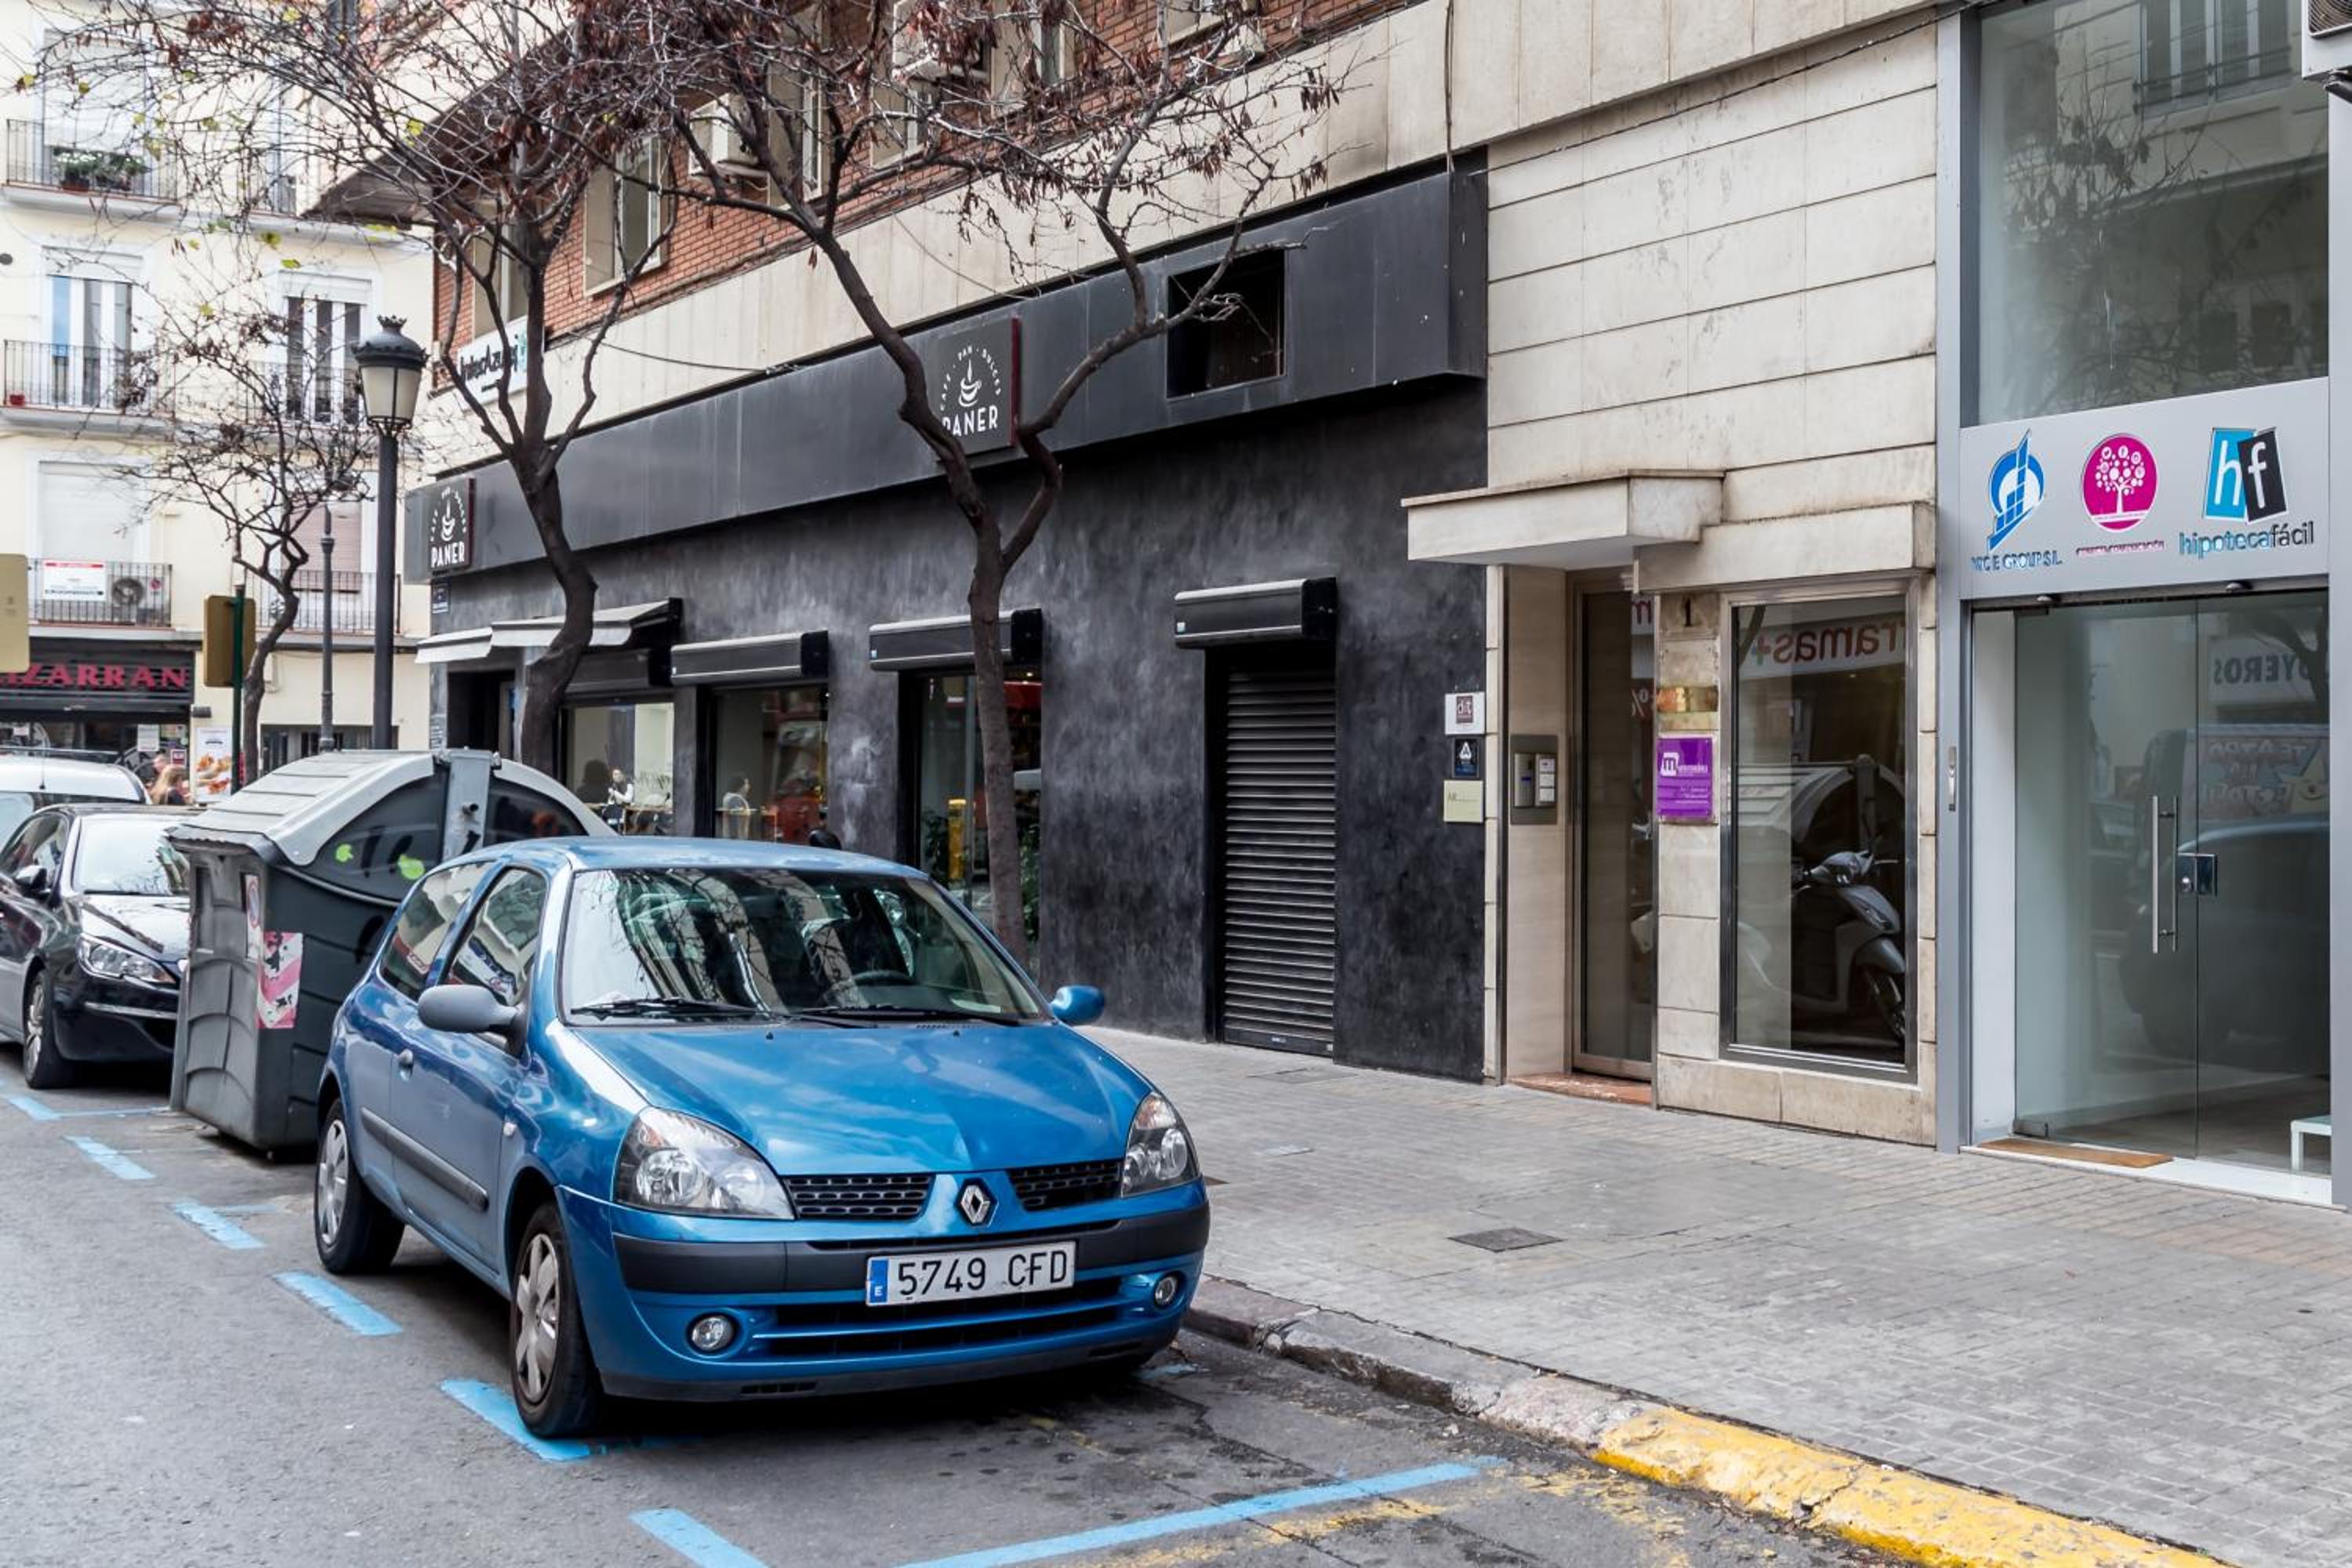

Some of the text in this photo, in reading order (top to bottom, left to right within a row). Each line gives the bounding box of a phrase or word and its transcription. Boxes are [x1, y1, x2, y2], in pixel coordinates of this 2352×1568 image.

[431, 541, 465, 568] PANER
[2180, 521, 2314, 559] hipotecafácil
[874, 1250, 1068, 1296] E 5749 CFD
